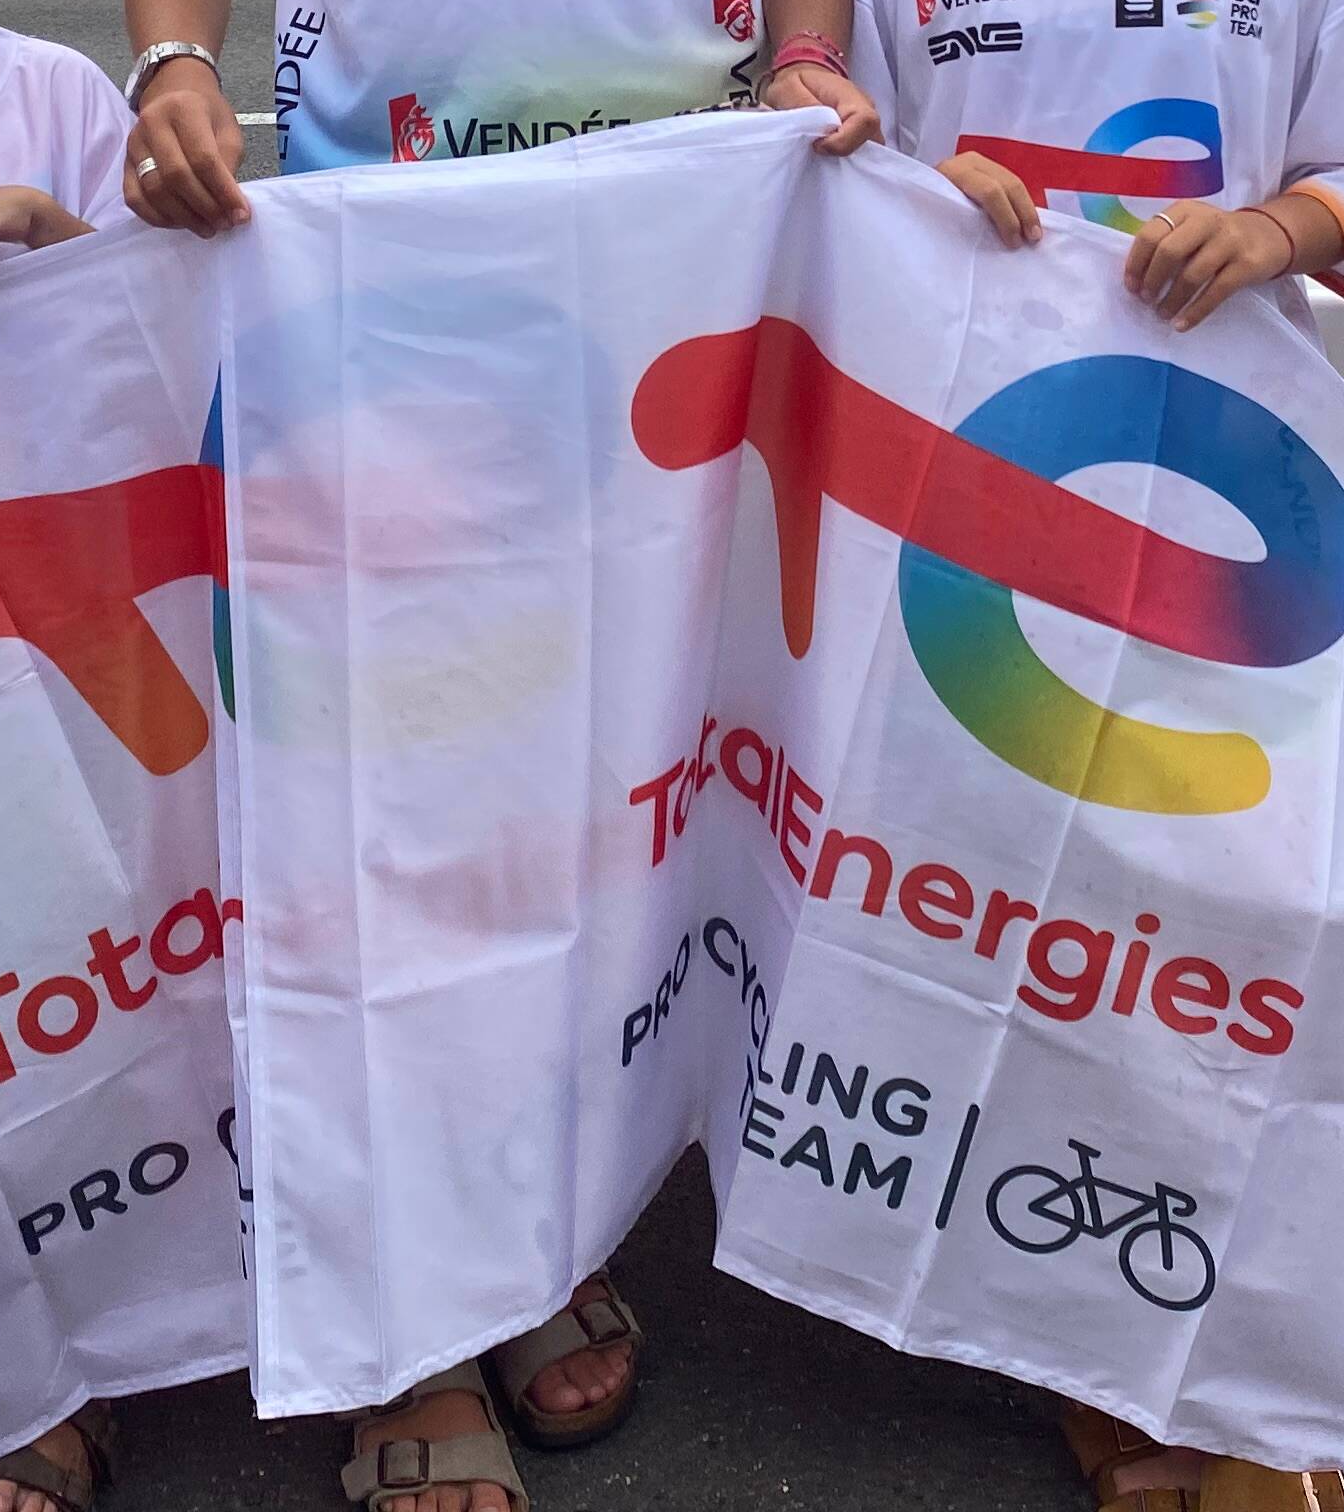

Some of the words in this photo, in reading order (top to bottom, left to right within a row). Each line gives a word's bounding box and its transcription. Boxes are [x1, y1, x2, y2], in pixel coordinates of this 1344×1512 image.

[630, 711, 1304, 1057] TotalEnergies
[620, 932, 691, 1067] PRO
[703, 917, 932, 1136] CYCLING
[18, 1142, 190, 1256] PRO
